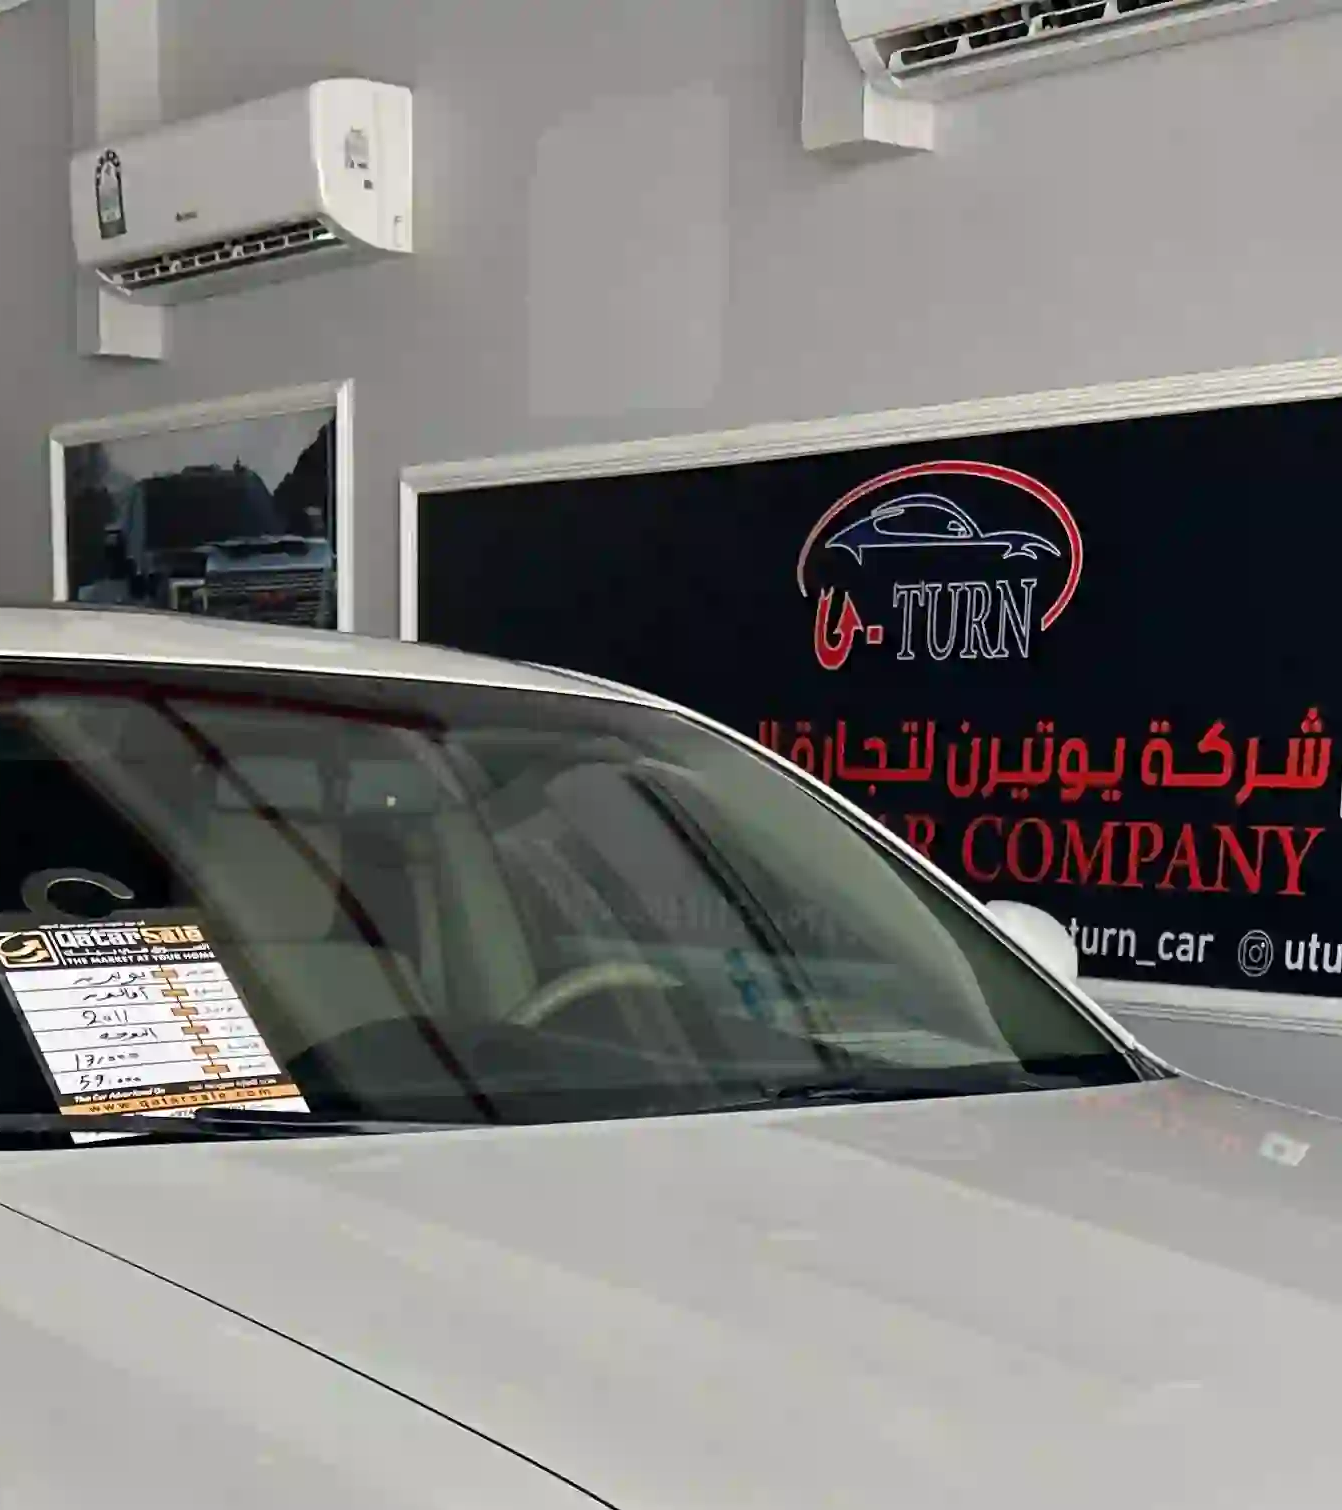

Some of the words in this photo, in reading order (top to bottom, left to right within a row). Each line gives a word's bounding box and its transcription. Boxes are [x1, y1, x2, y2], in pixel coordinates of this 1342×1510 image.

[790, 719, 936, 797] لتجارة
[947, 720, 1127, 802] يوتيرن
[1140, 706, 1333, 806] شركة
[961, 815, 1328, 897] COMPANY
[67, 956, 88, 966] THE
[90, 954, 134, 965] MARKET
[136, 953, 150, 963] AT
[152, 951, 182, 963] YOUR
[182, 950, 216, 962] HOME
[1065, 916, 1215, 968] turn_car
